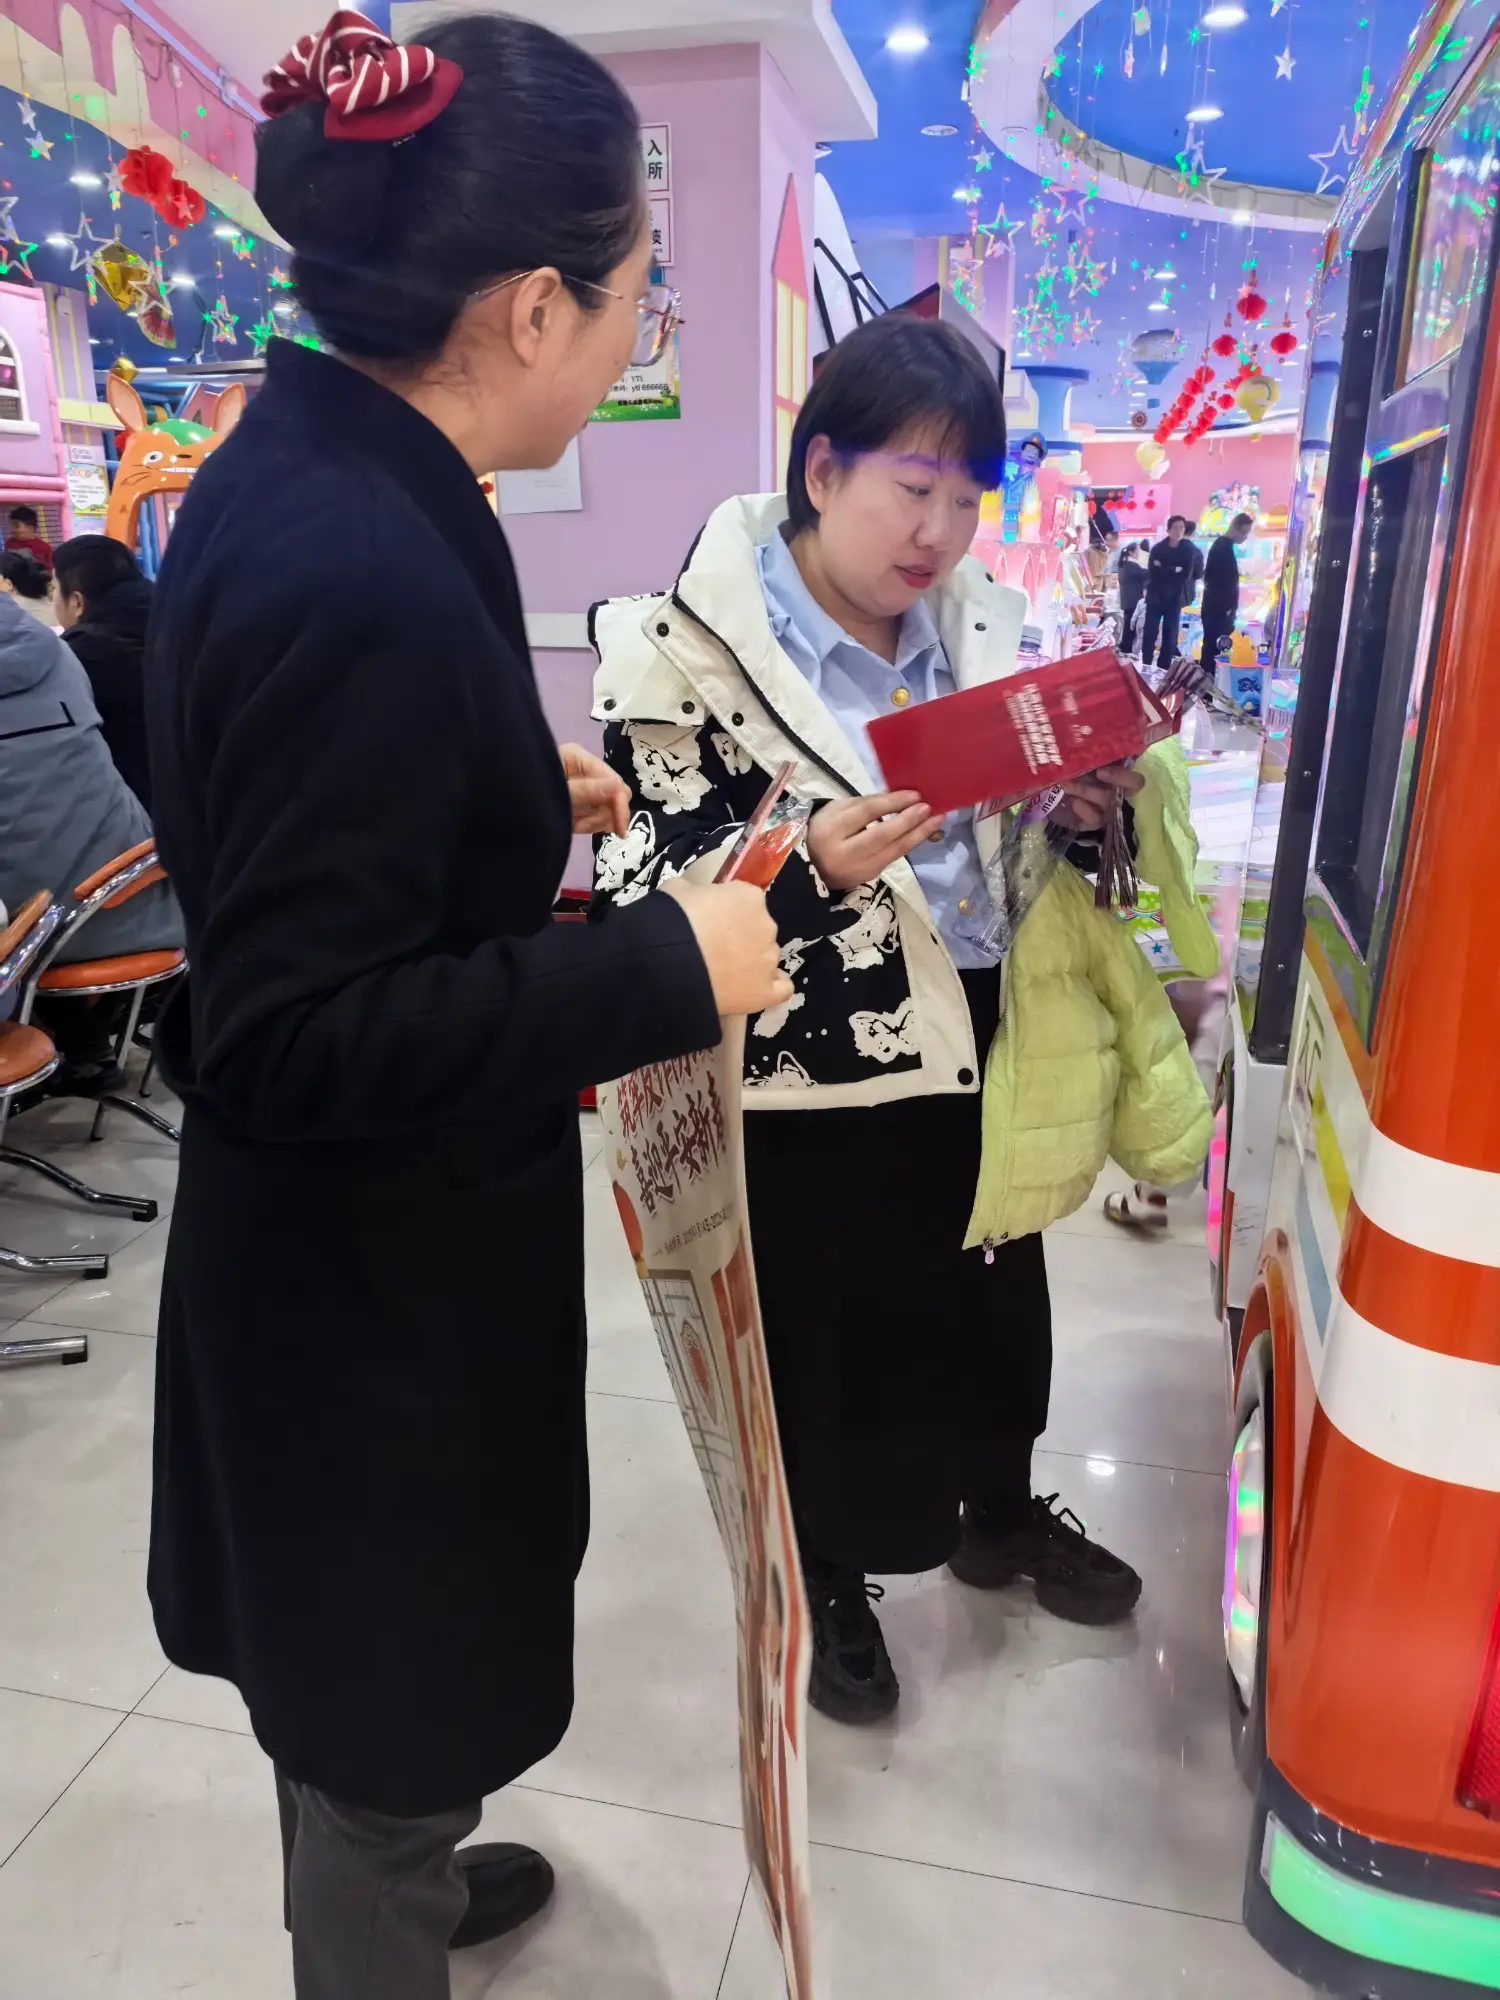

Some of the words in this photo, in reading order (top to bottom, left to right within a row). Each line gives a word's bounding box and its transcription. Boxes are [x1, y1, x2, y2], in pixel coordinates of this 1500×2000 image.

[647, 139, 663, 157] 入
[647, 161, 663, 180] 所
[1041, 785, 1061, 813] 百岁山
